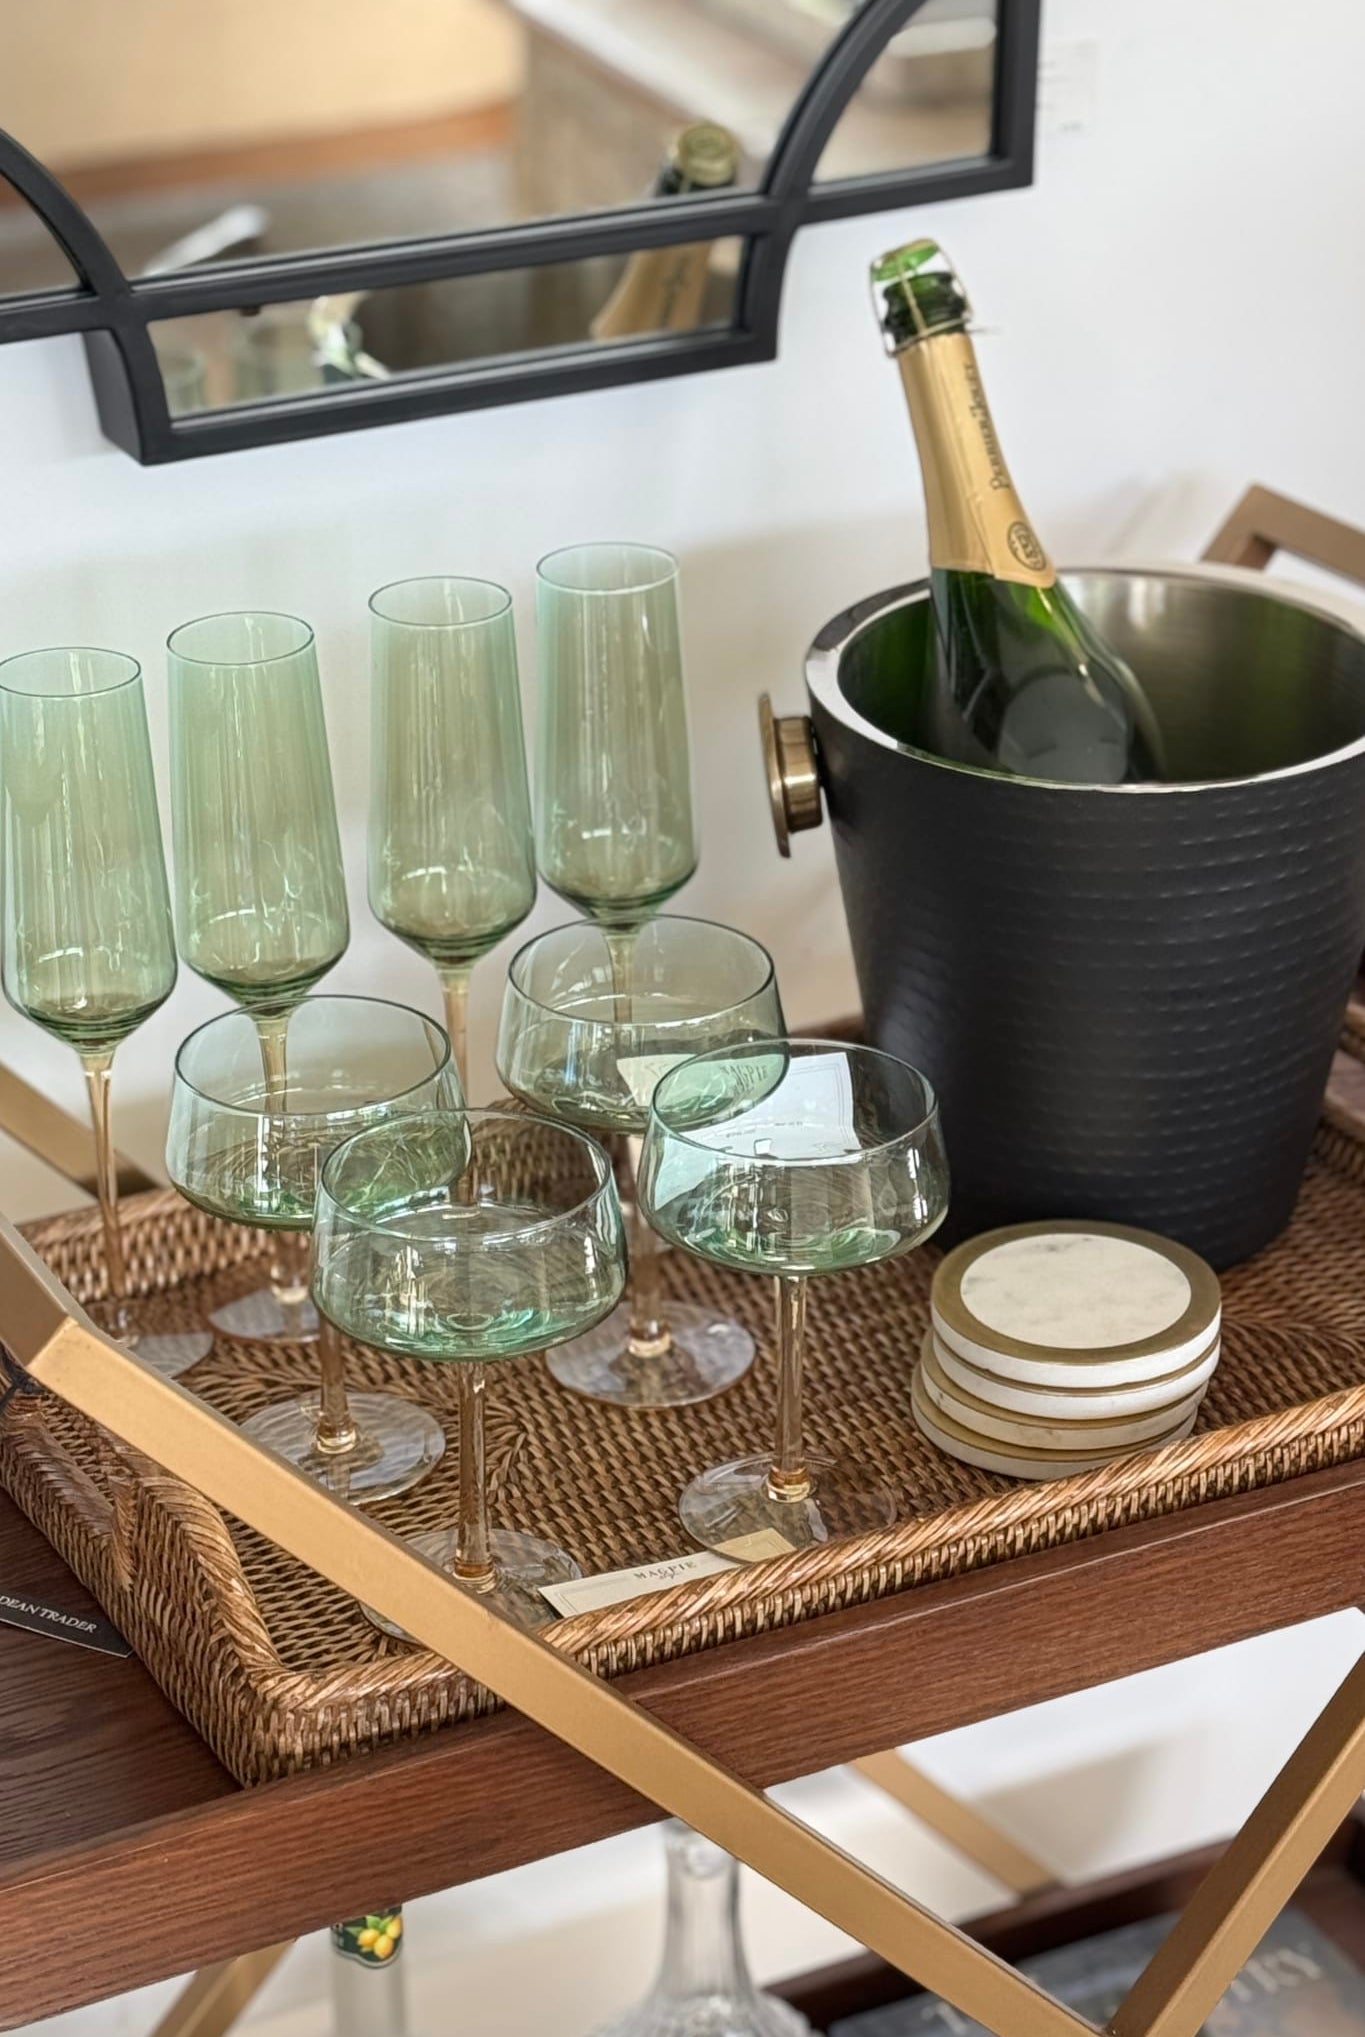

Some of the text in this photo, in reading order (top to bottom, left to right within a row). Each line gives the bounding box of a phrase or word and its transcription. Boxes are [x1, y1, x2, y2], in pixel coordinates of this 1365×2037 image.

[633, 1561, 697, 1579] MAGPIE
[0, 1595, 97, 1633] DEAN TRADER
